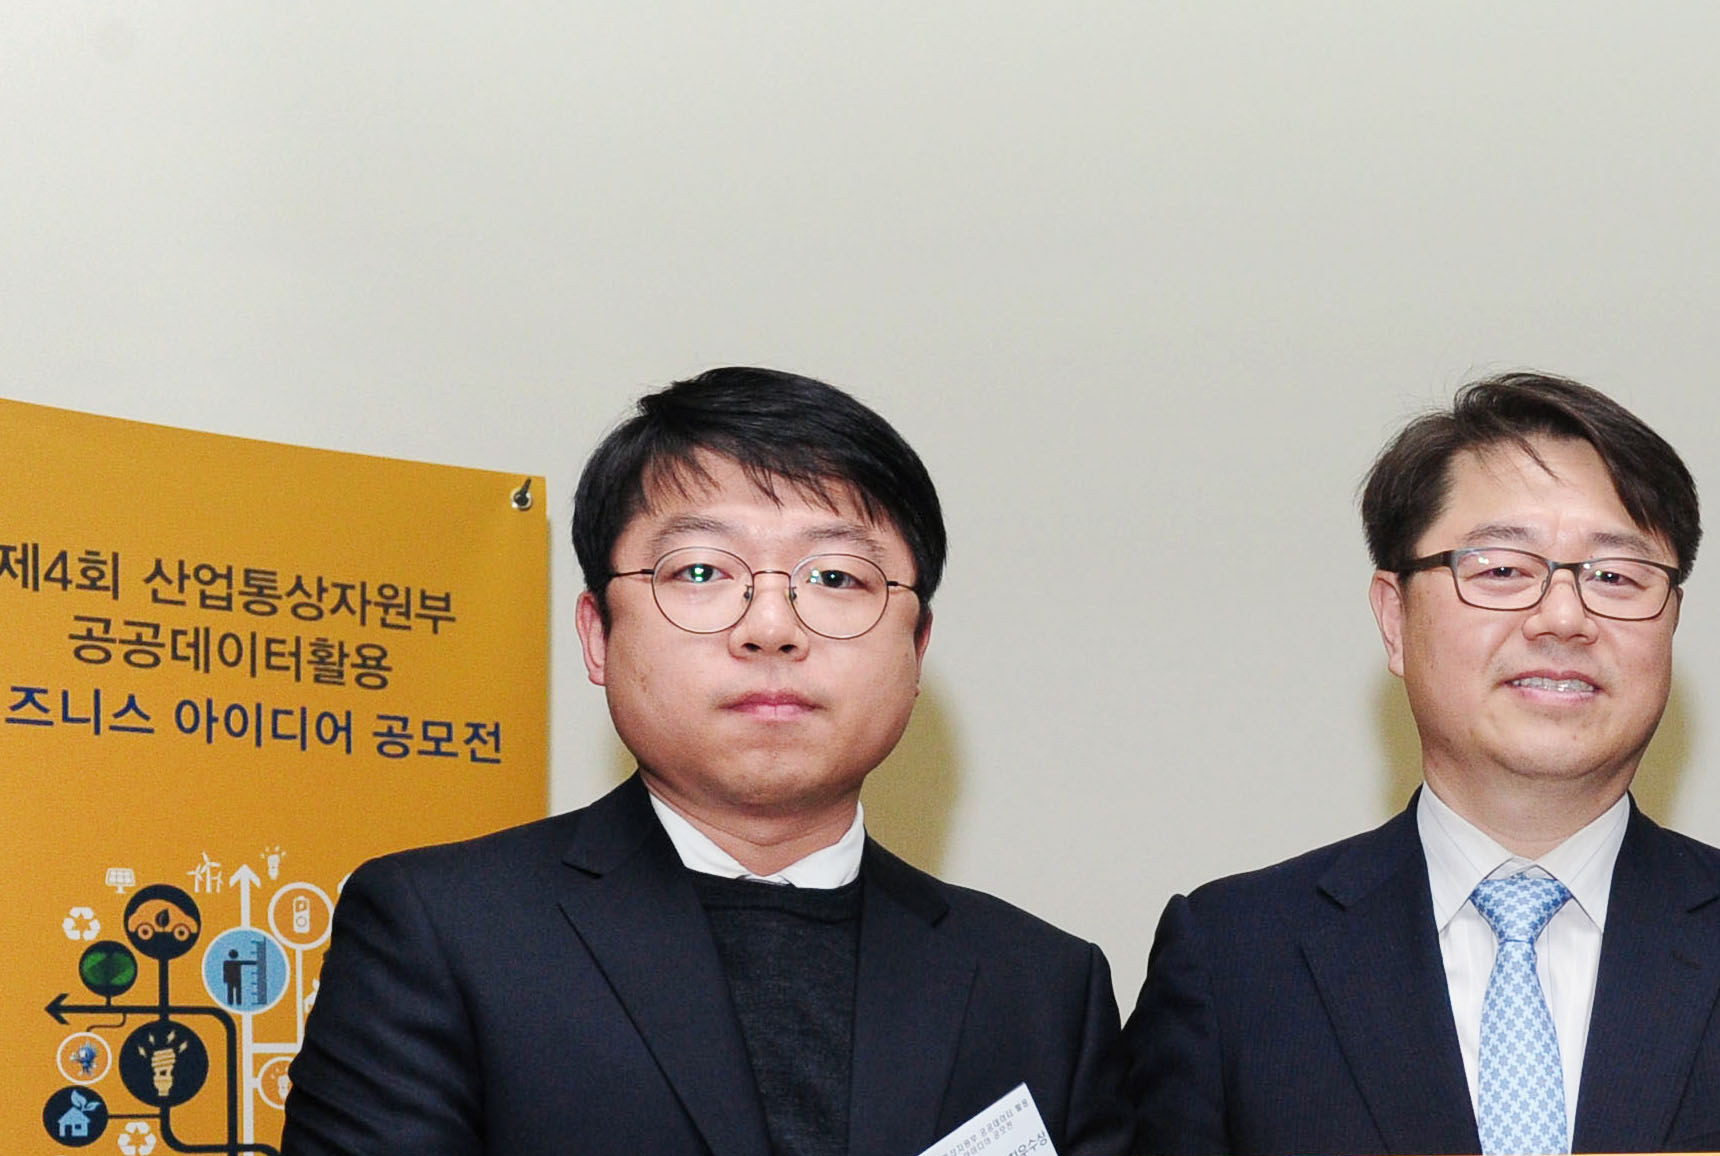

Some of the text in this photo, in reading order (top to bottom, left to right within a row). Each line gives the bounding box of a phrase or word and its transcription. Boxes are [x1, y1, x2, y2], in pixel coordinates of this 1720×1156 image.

[0, 542, 456, 635] 제4회 산업통상자원부
[69, 614, 392, 690] 공공데이터활용
[5, 685, 502, 764] 즈니스 아이디어 공모전
